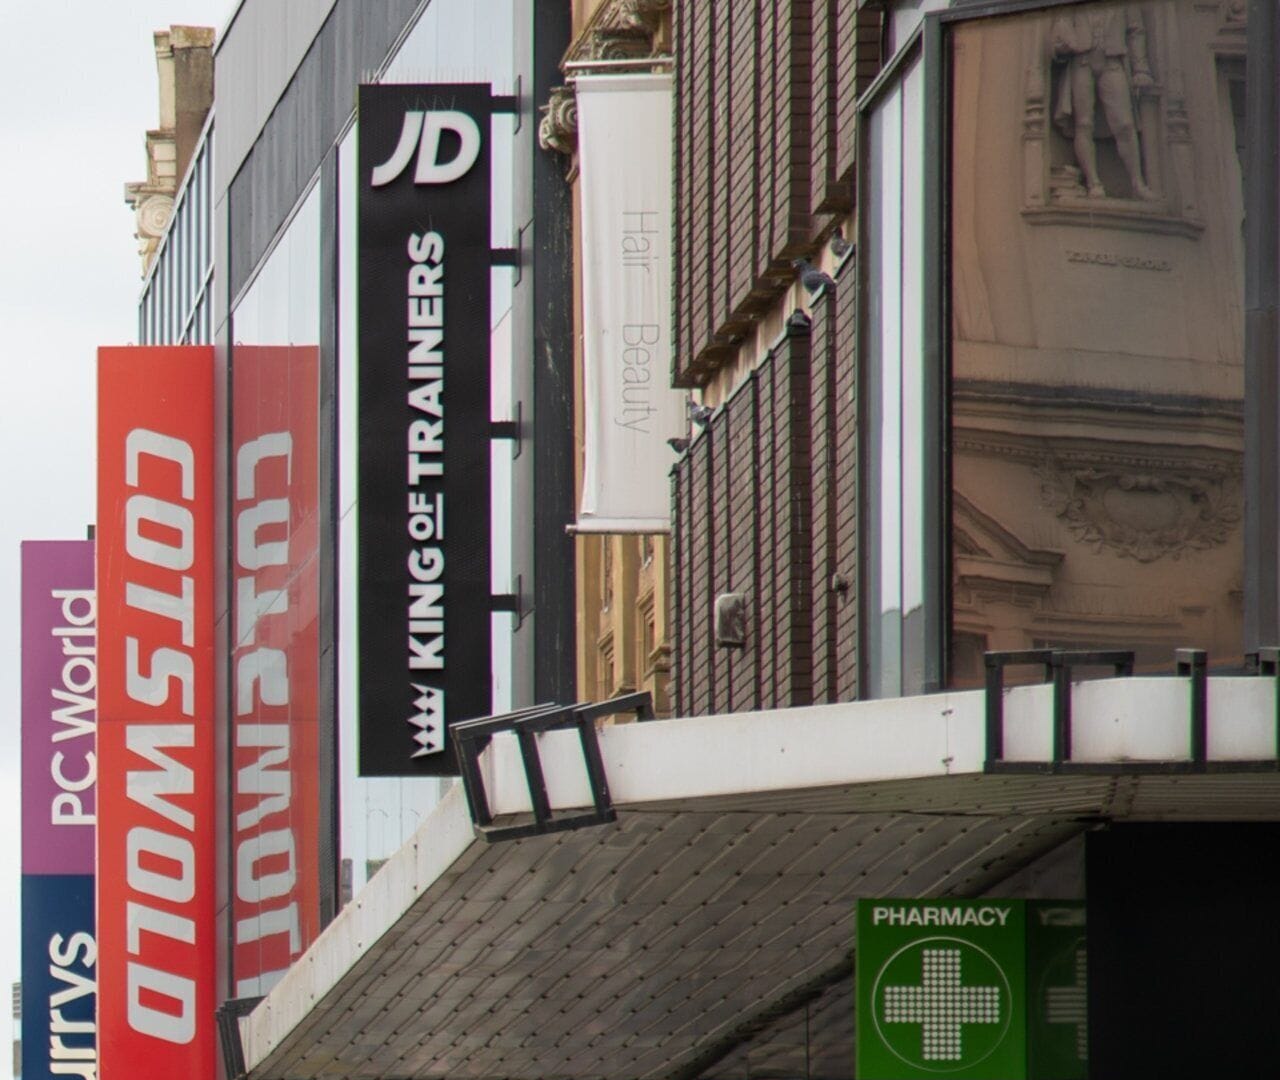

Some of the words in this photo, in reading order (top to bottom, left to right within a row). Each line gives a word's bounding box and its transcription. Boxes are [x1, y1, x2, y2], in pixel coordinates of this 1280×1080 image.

[371, 110, 482, 188] JD
[621, 210, 659, 274] Hair
[407, 229, 445, 486] TRAINERS
[613, 322, 660, 435] Beauty
[407, 492, 444, 542] OF
[407, 547, 445, 670] KING
[50, 588, 96, 744] World
[126, 427, 196, 1045] COTSWOLD
[50, 751, 96, 825] PC
[872, 907, 1011, 926] PHARMACY
